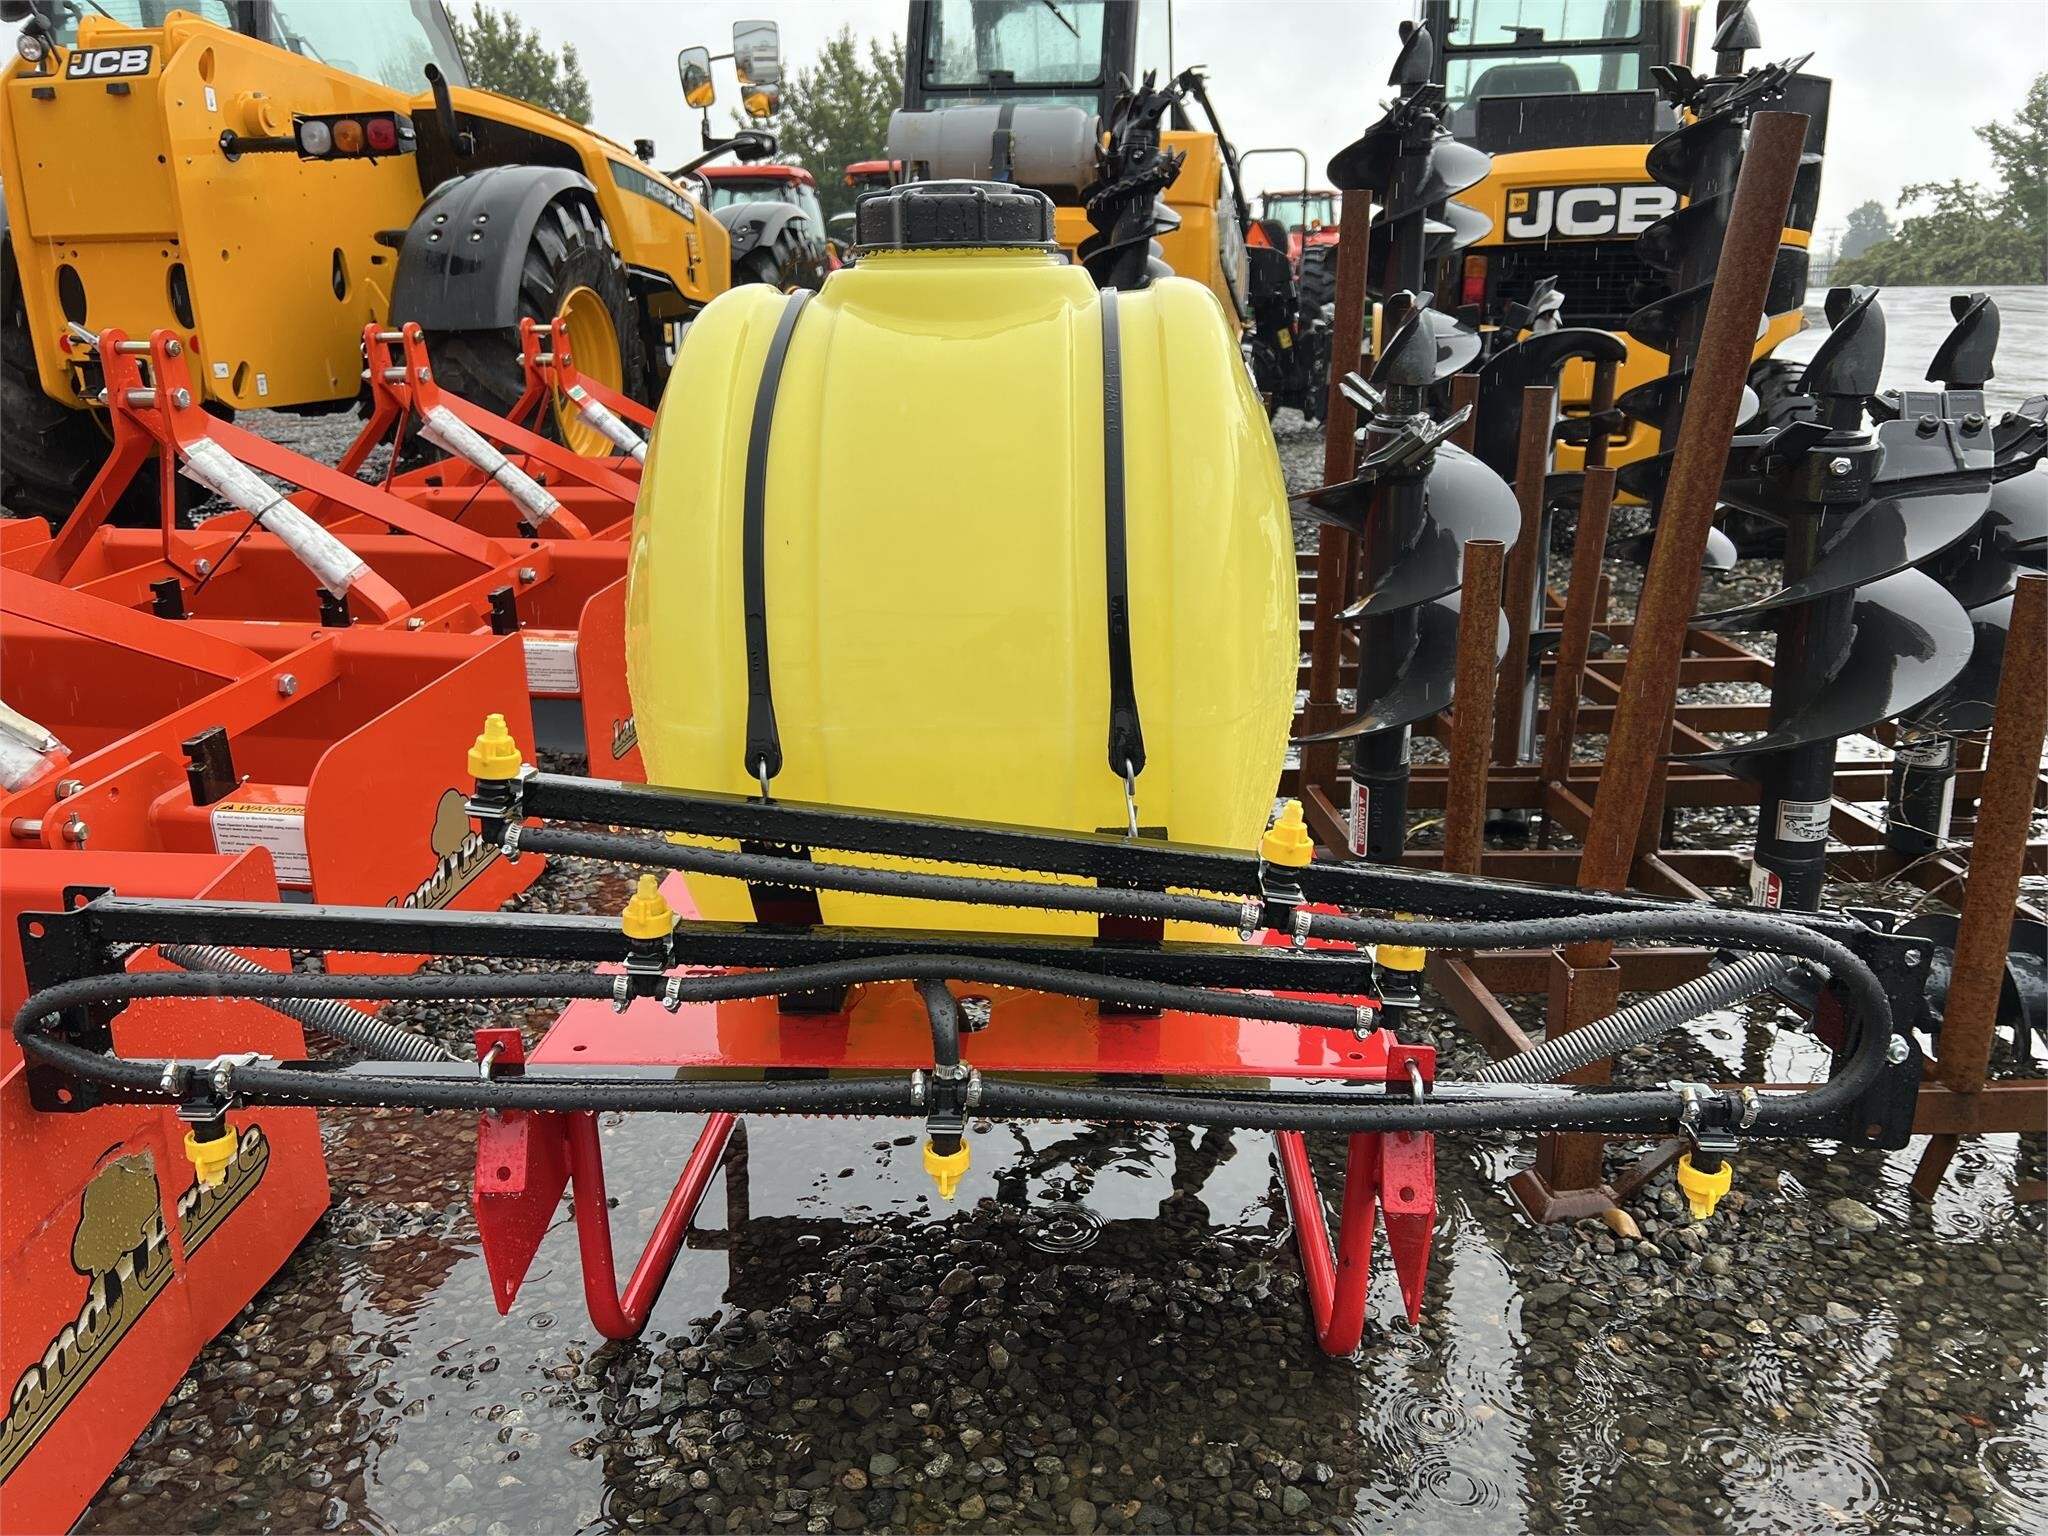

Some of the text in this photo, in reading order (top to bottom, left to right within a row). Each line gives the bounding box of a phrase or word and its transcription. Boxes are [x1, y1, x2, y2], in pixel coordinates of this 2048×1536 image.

[69, 50, 148, 76] JCB
[1507, 187, 1678, 238] JCB
[1356, 806, 1367, 846] DANGER
